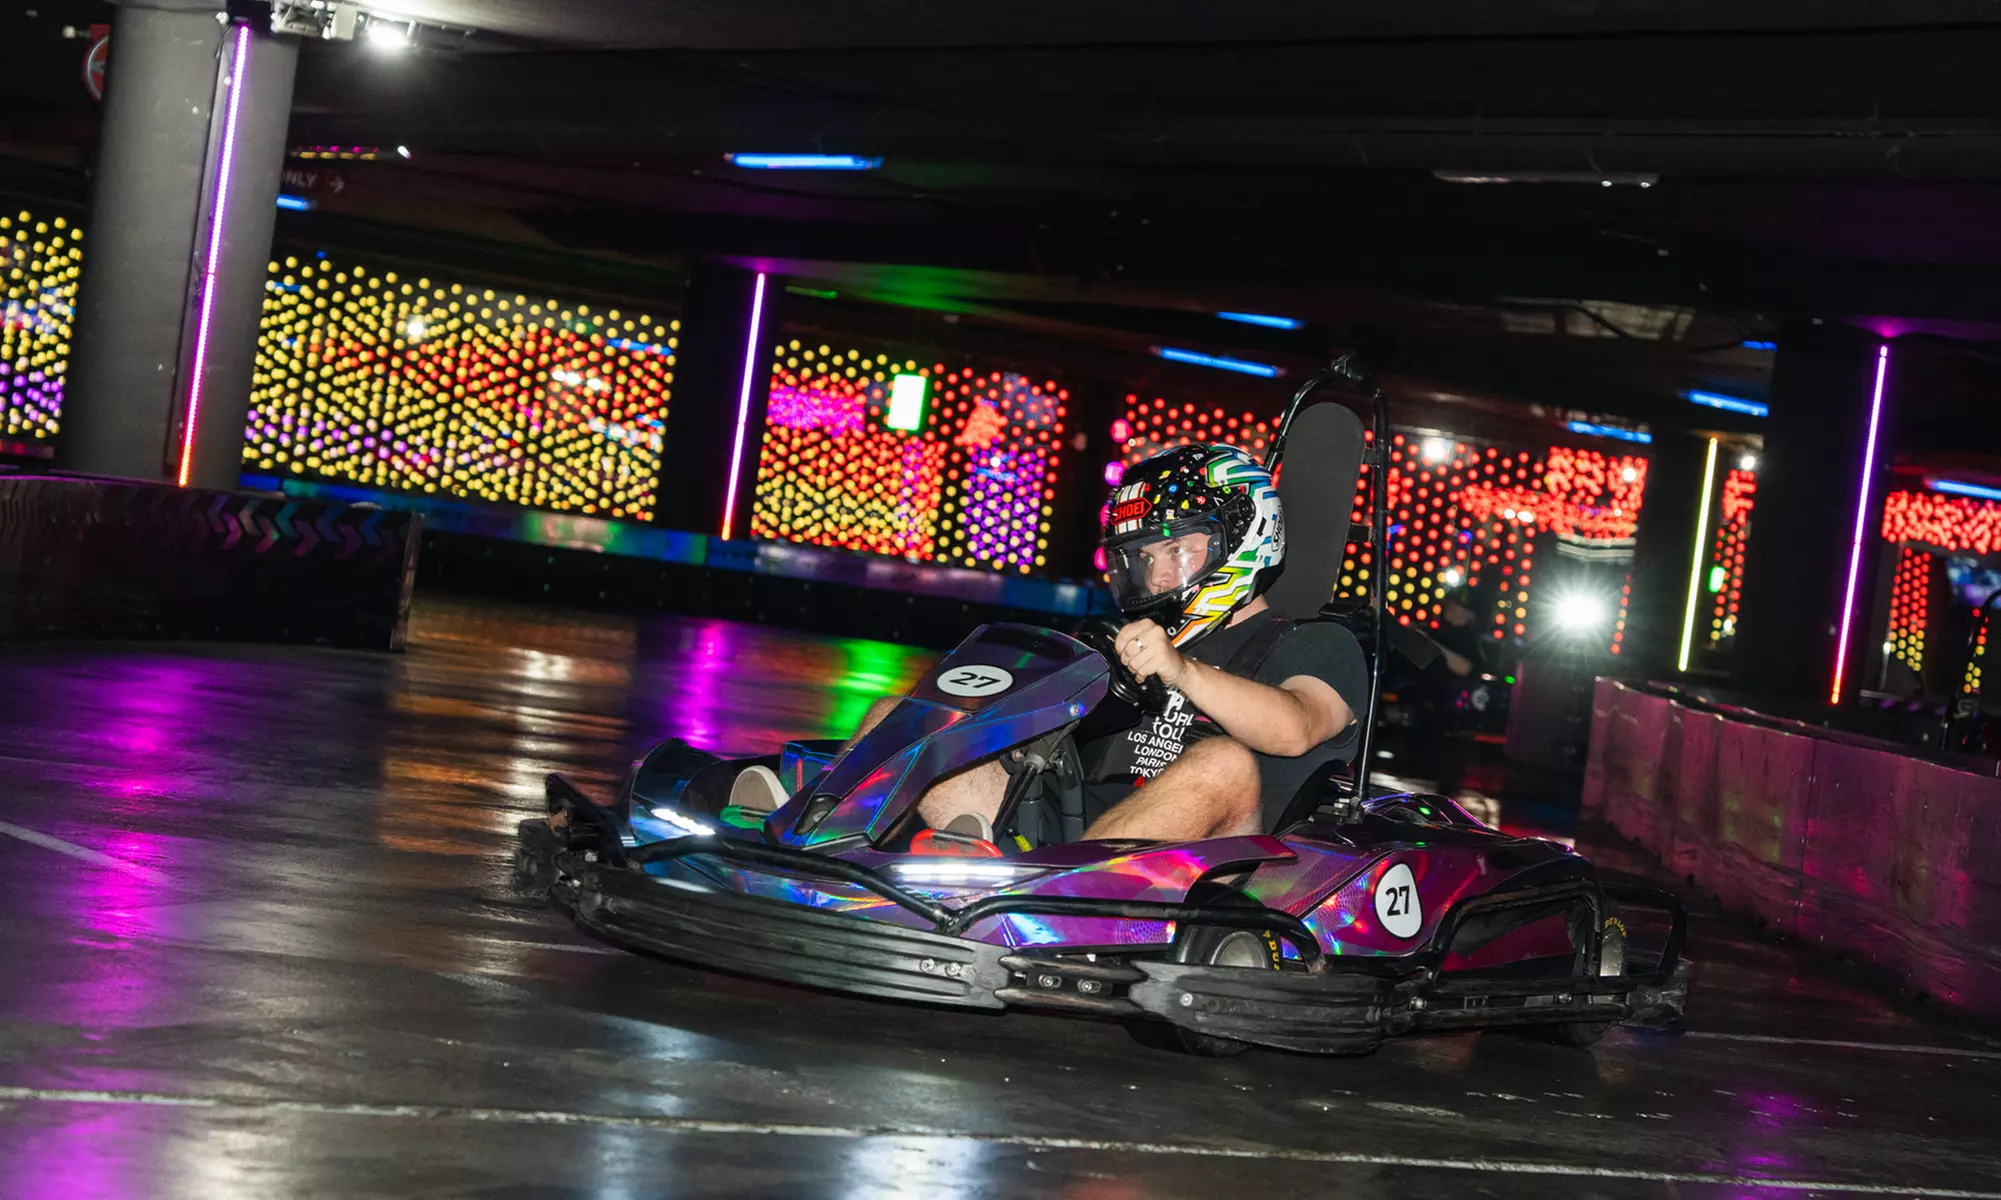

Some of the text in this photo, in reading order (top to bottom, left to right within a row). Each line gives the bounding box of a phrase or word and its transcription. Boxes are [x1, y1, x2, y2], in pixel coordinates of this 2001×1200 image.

[948, 671, 1001, 688] 27
[1127, 731, 1147, 744] LOS
[1385, 885, 1410, 916] 27
